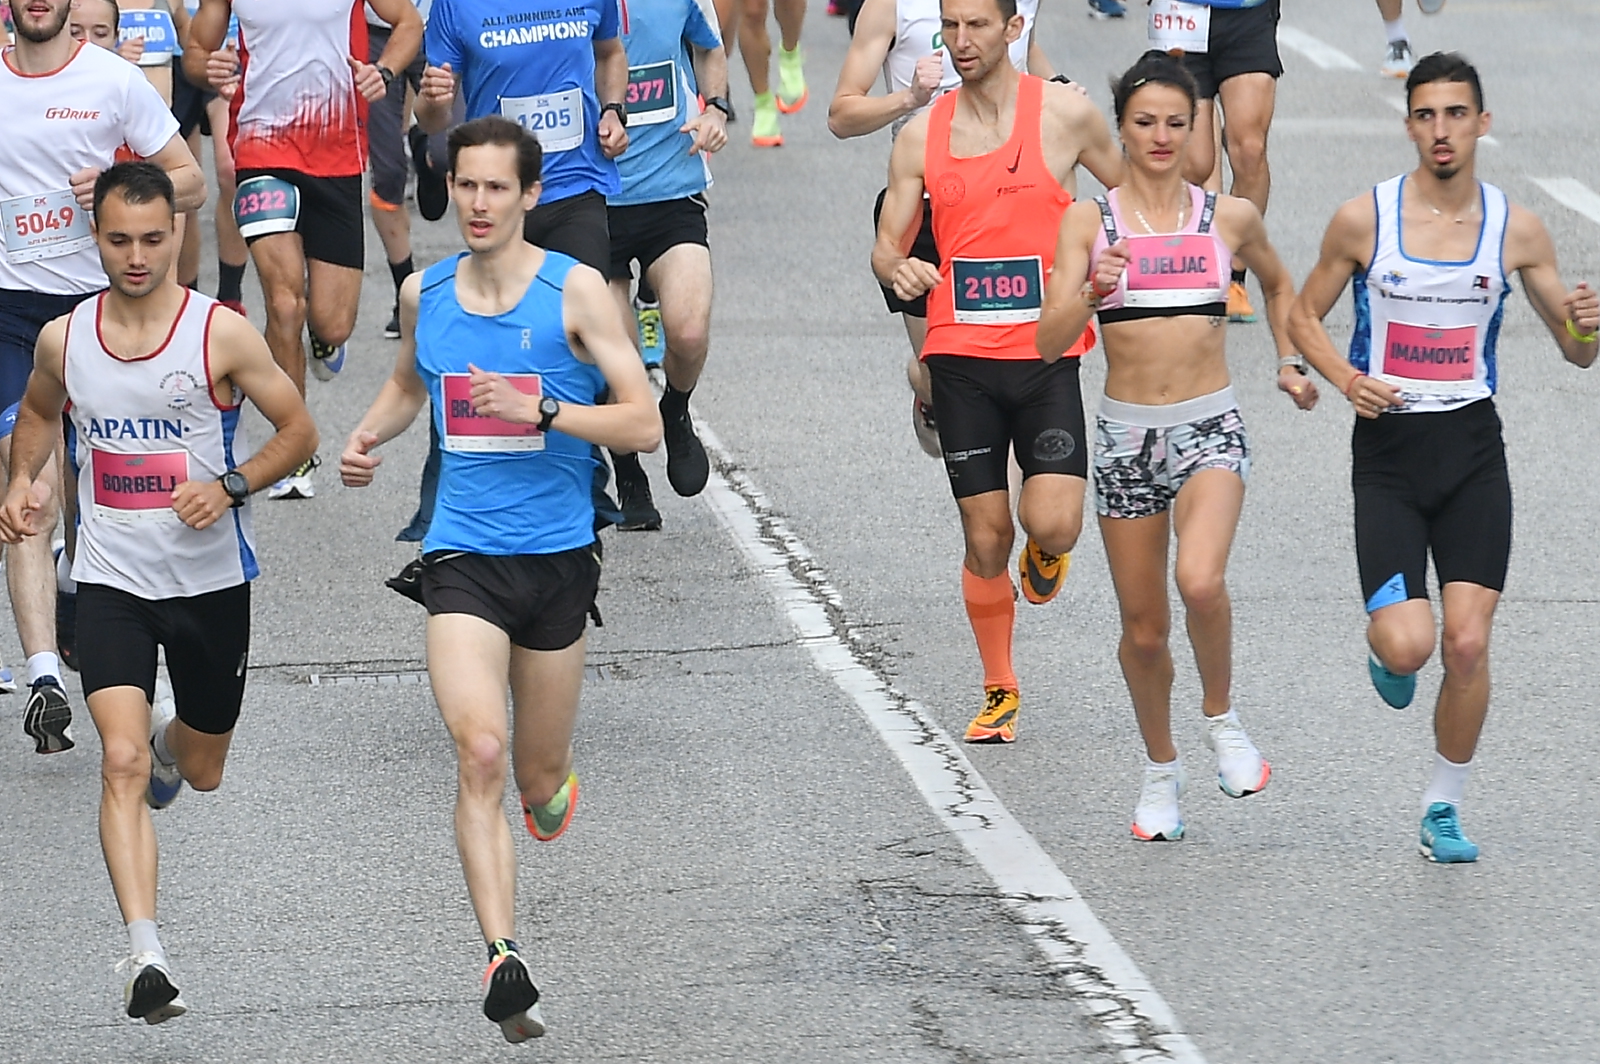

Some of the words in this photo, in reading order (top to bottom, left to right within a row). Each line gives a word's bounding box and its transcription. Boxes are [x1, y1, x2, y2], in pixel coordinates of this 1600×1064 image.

[482, 15, 503, 28] ALL
[507, 9, 562, 25] RUNNERS
[1154, 13, 1197, 31] 5116
[480, 20, 589, 49] CHAMPIONS
[626, 77, 665, 104] 377
[517, 108, 571, 131] 1205
[238, 189, 287, 216] 2322
[14, 206, 75, 237] 5049
[1139, 255, 1208, 275] BJELJAC
[964, 275, 1028, 299] 2180
[1390, 340, 1471, 365] IMAMOVIĆ
